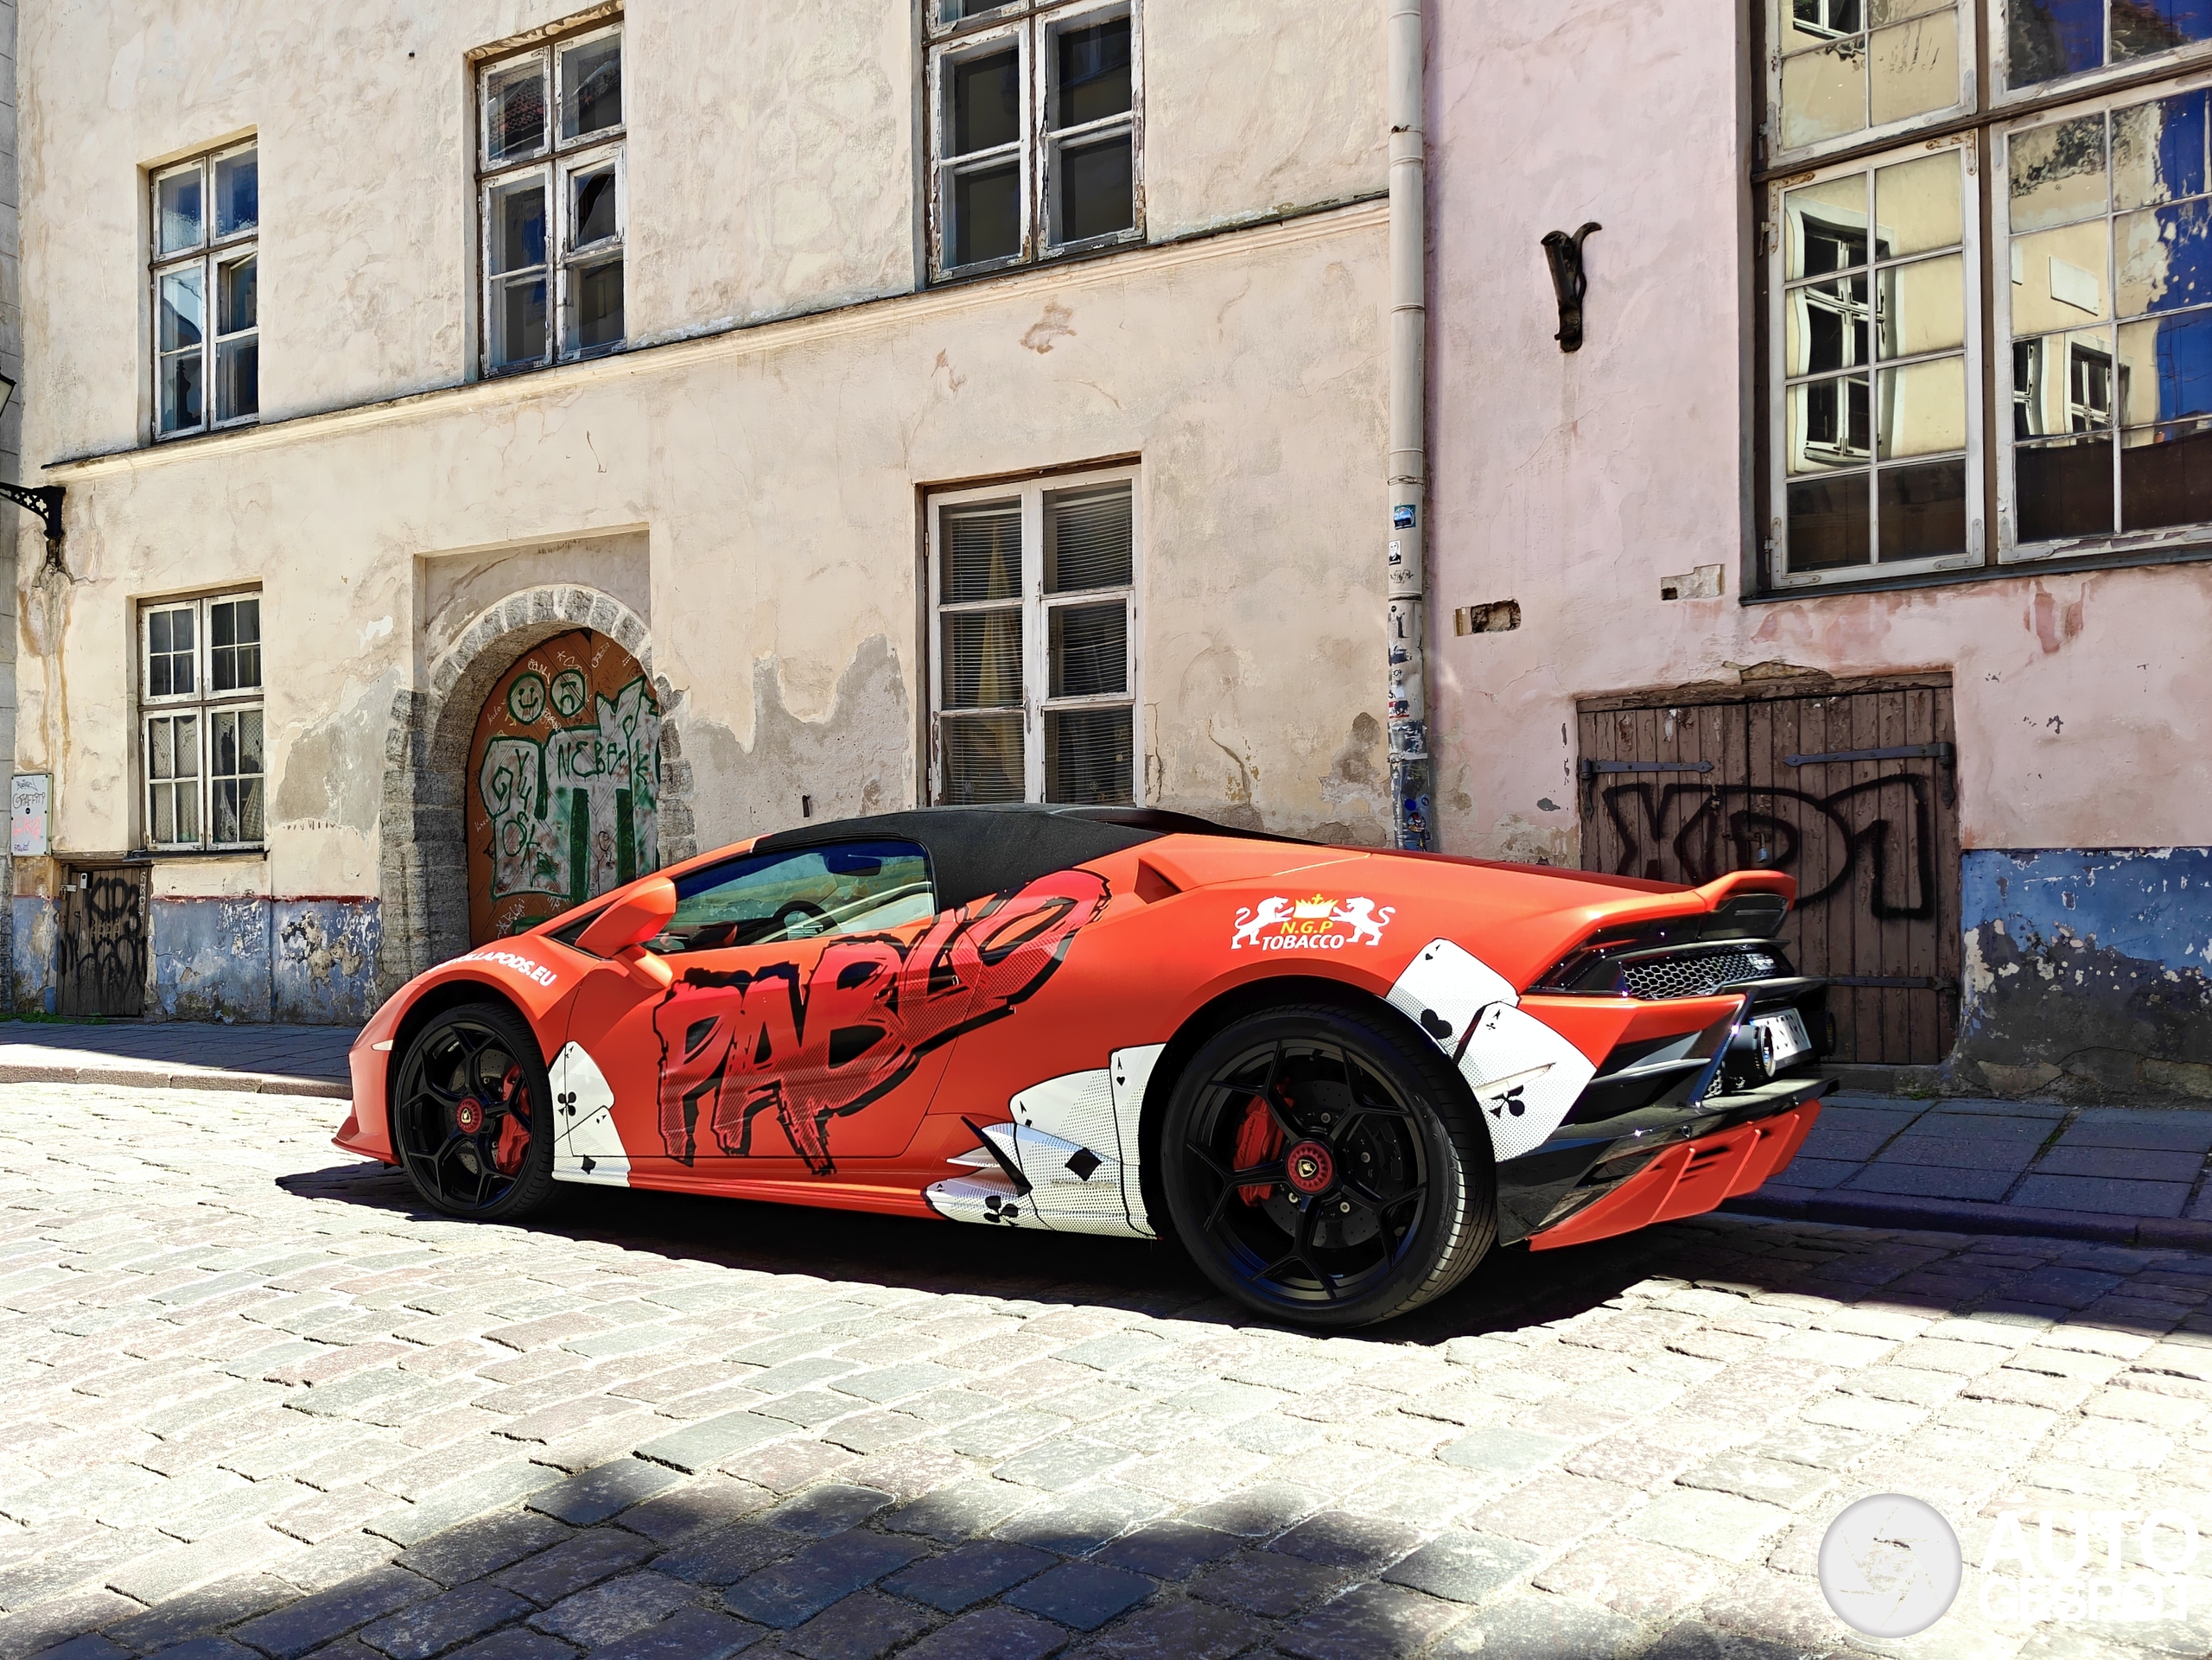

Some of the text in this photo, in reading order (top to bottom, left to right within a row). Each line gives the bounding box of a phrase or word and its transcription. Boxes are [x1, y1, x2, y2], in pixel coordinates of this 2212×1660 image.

[1280, 920, 1334, 935] N.G.P
[1261, 934, 1345, 951] TOBACCO
[653, 868, 1112, 1175] PABLO
[1117, 1057, 1122, 1071] A
[1020, 1100, 1027, 1115] A
